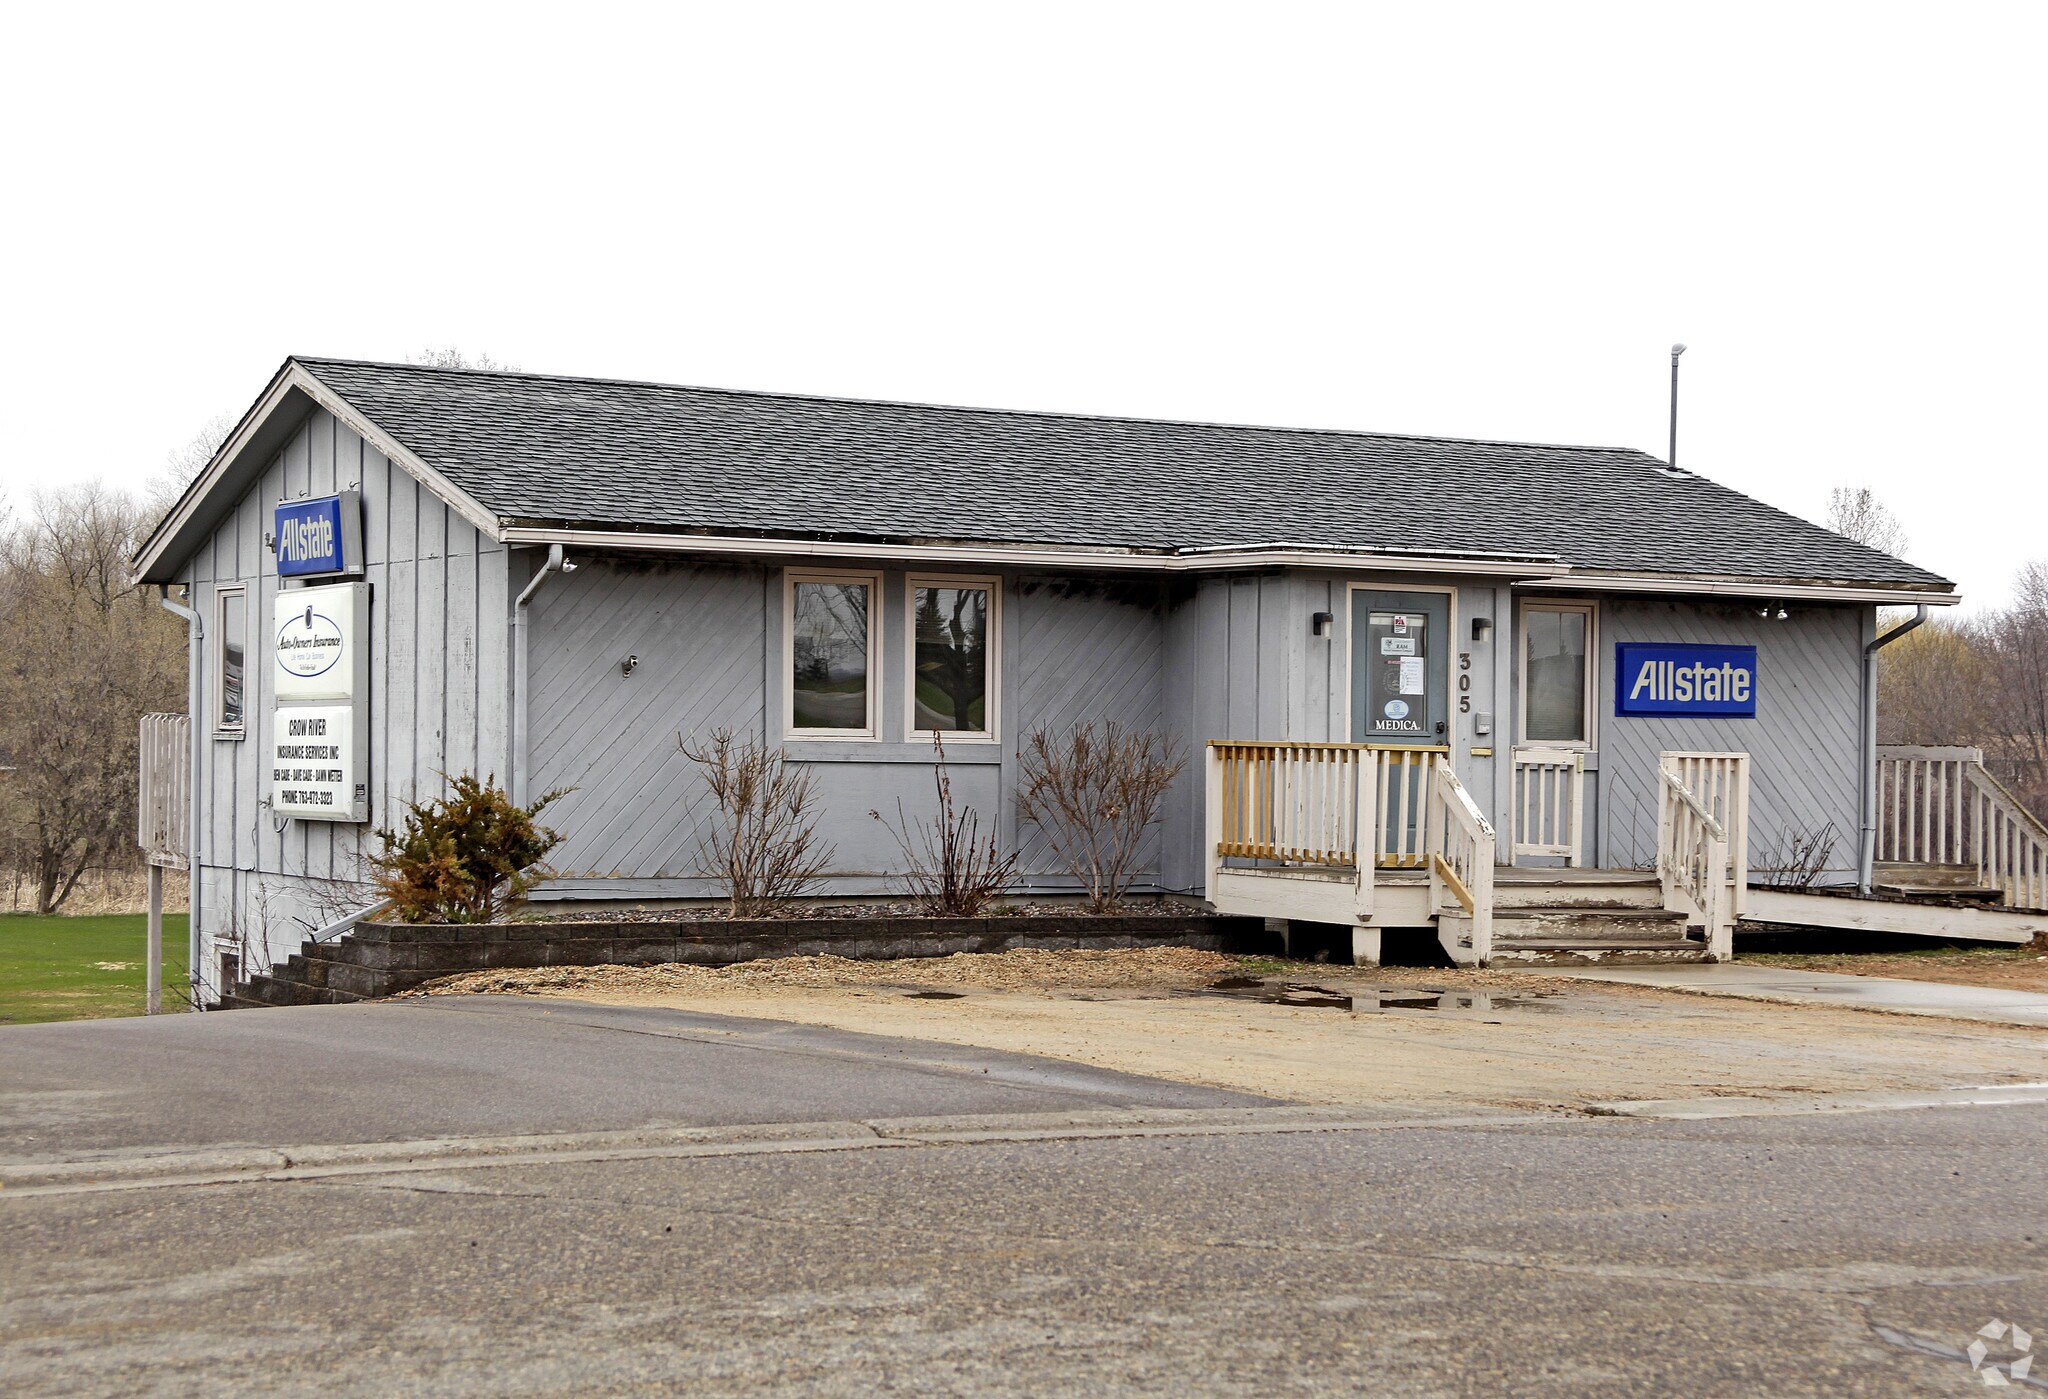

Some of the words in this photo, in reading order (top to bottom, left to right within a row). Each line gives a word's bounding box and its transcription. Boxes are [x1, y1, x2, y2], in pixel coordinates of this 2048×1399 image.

[279, 514, 333, 562] Allstate
[313, 634, 341, 648] Insurance
[1459, 653, 1471, 713] 305
[1629, 660, 1750, 702] Allstate
[289, 719, 307, 736] CROW
[308, 719, 326, 736] RIVER
[277, 745, 304, 759] INSURANCE
[305, 745, 328, 760] SERVICES
[329, 745, 339, 759] INC
[281, 790, 298, 804] PHONE
